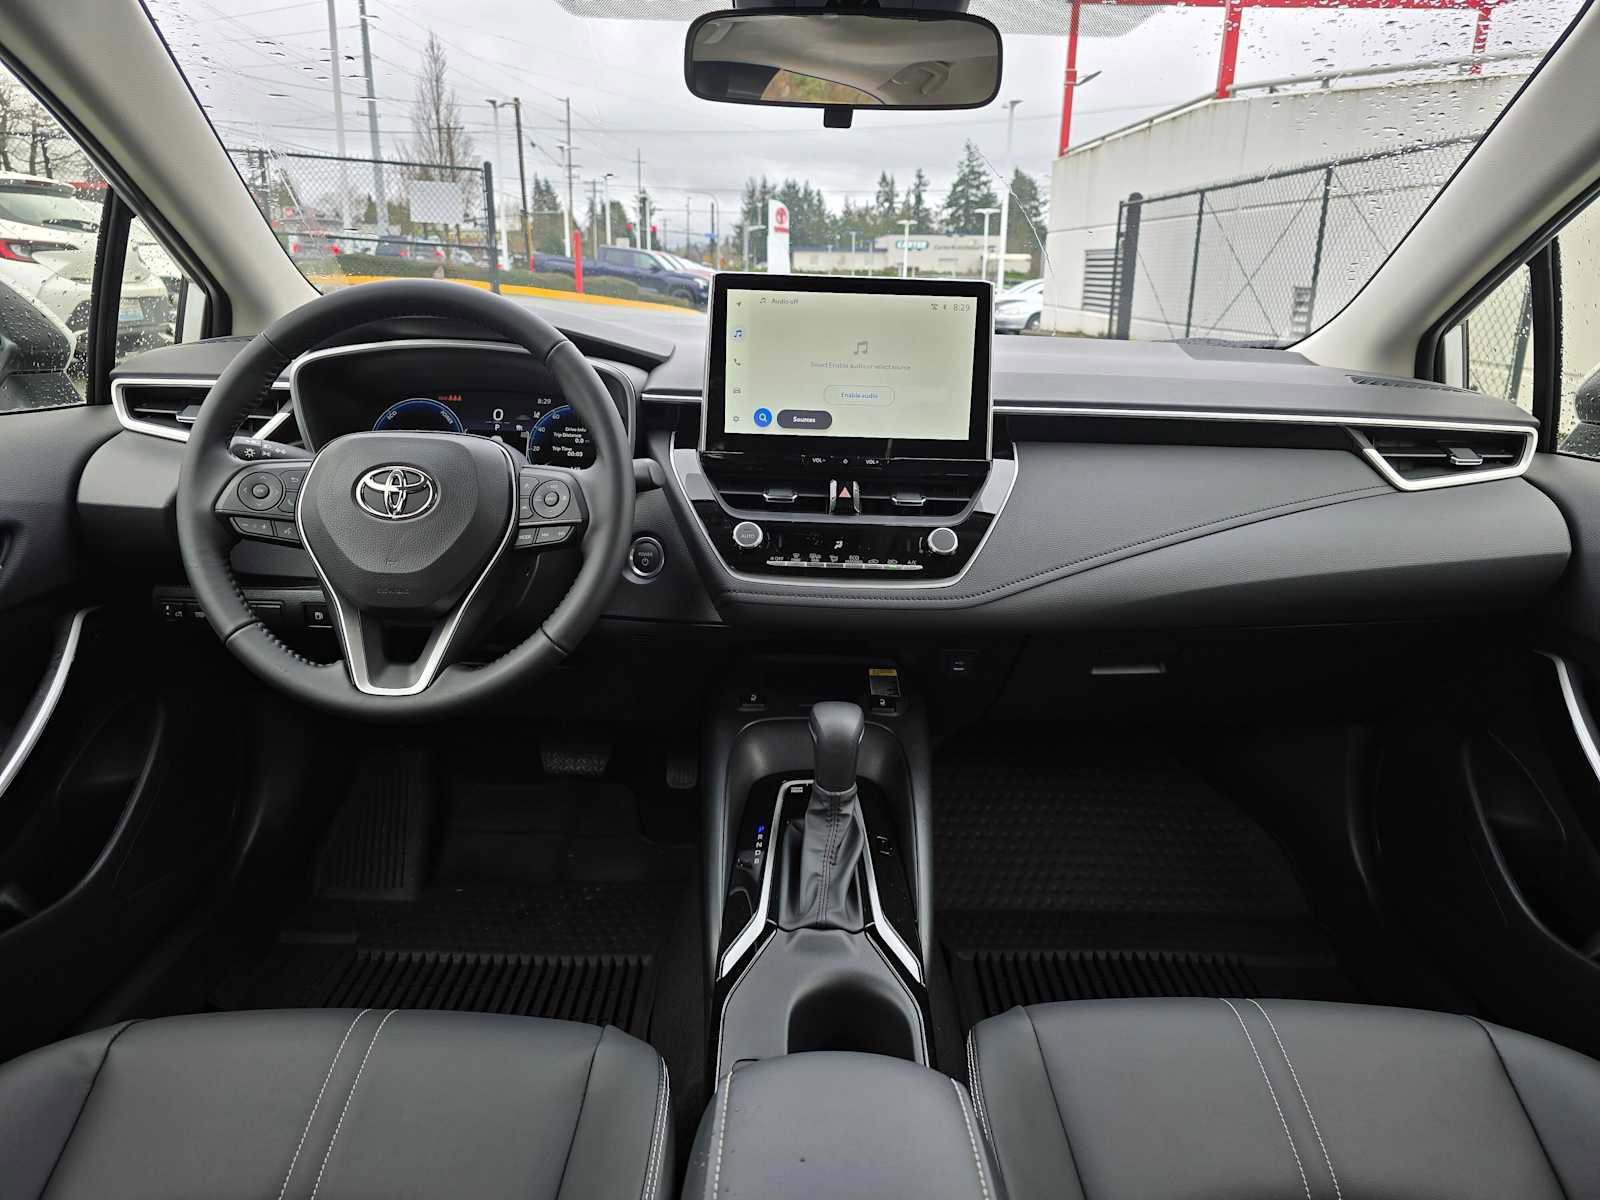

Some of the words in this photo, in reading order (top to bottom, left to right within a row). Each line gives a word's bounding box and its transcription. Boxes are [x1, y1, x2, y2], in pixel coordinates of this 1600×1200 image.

[953, 303, 970, 313] 8:29
[493, 408, 504, 421] 0
[792, 416, 816, 424] Sources
